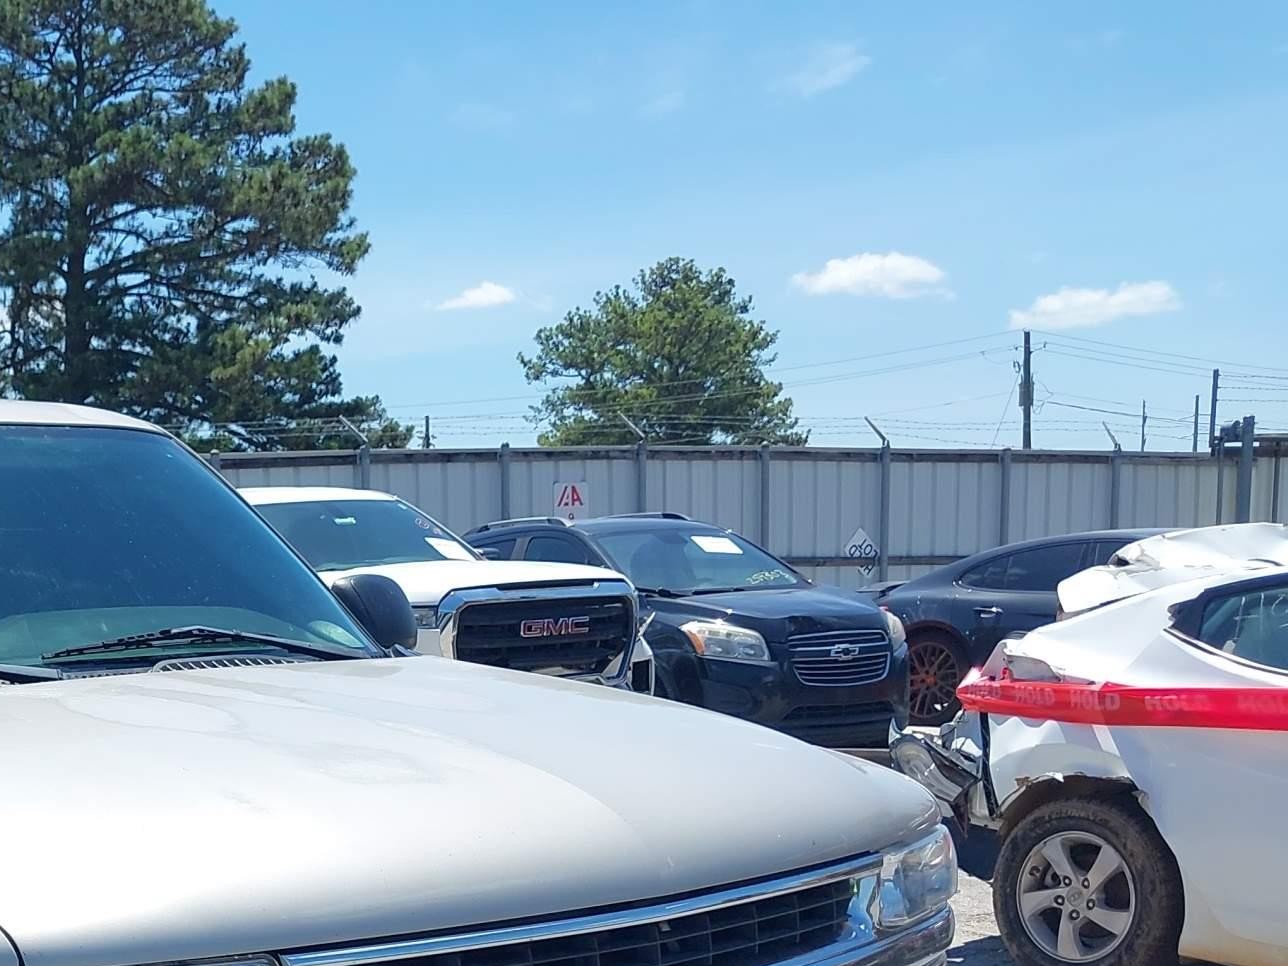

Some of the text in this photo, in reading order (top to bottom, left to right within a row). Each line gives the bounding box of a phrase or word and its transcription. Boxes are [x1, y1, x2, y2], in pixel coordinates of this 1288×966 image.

[520, 616, 590, 638] GMC
[1014, 684, 1056, 706] HOLD
[1069, 689, 1121, 712] HOLD
